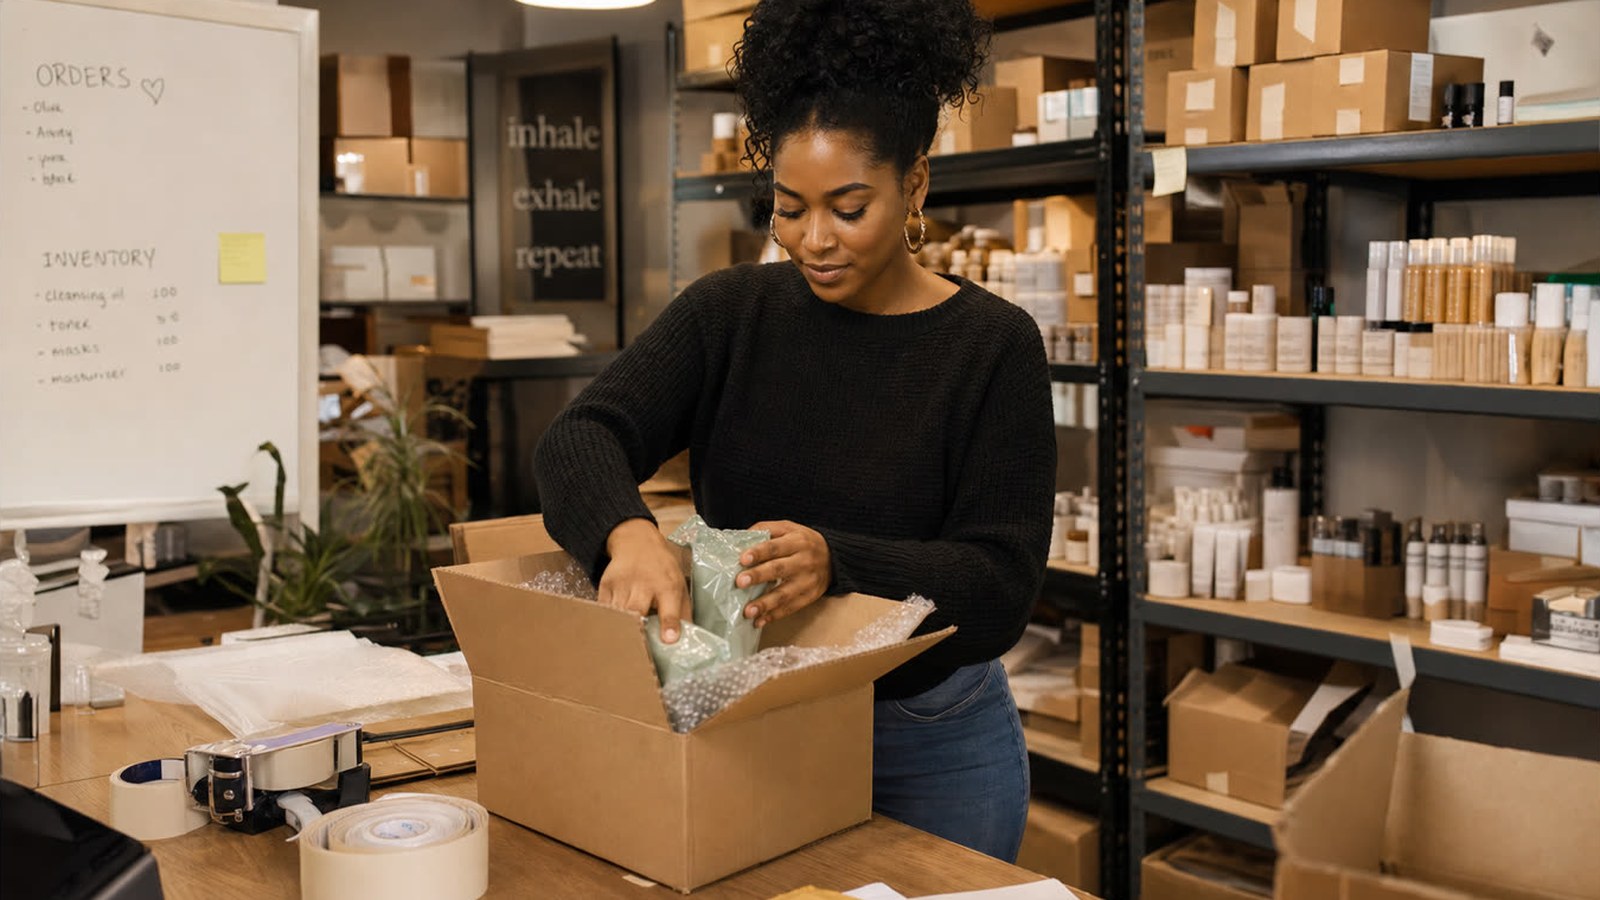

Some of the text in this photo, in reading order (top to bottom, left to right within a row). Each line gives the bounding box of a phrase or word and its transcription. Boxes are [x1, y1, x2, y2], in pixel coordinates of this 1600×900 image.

[36, 63, 131, 88] ORDERS
[507, 115, 600, 149] inhale
[513, 179, 600, 211] exhale
[43, 248, 155, 268] INVENTORY
[515, 245, 601, 277] repeat
[45, 288, 106, 309] cleansing
